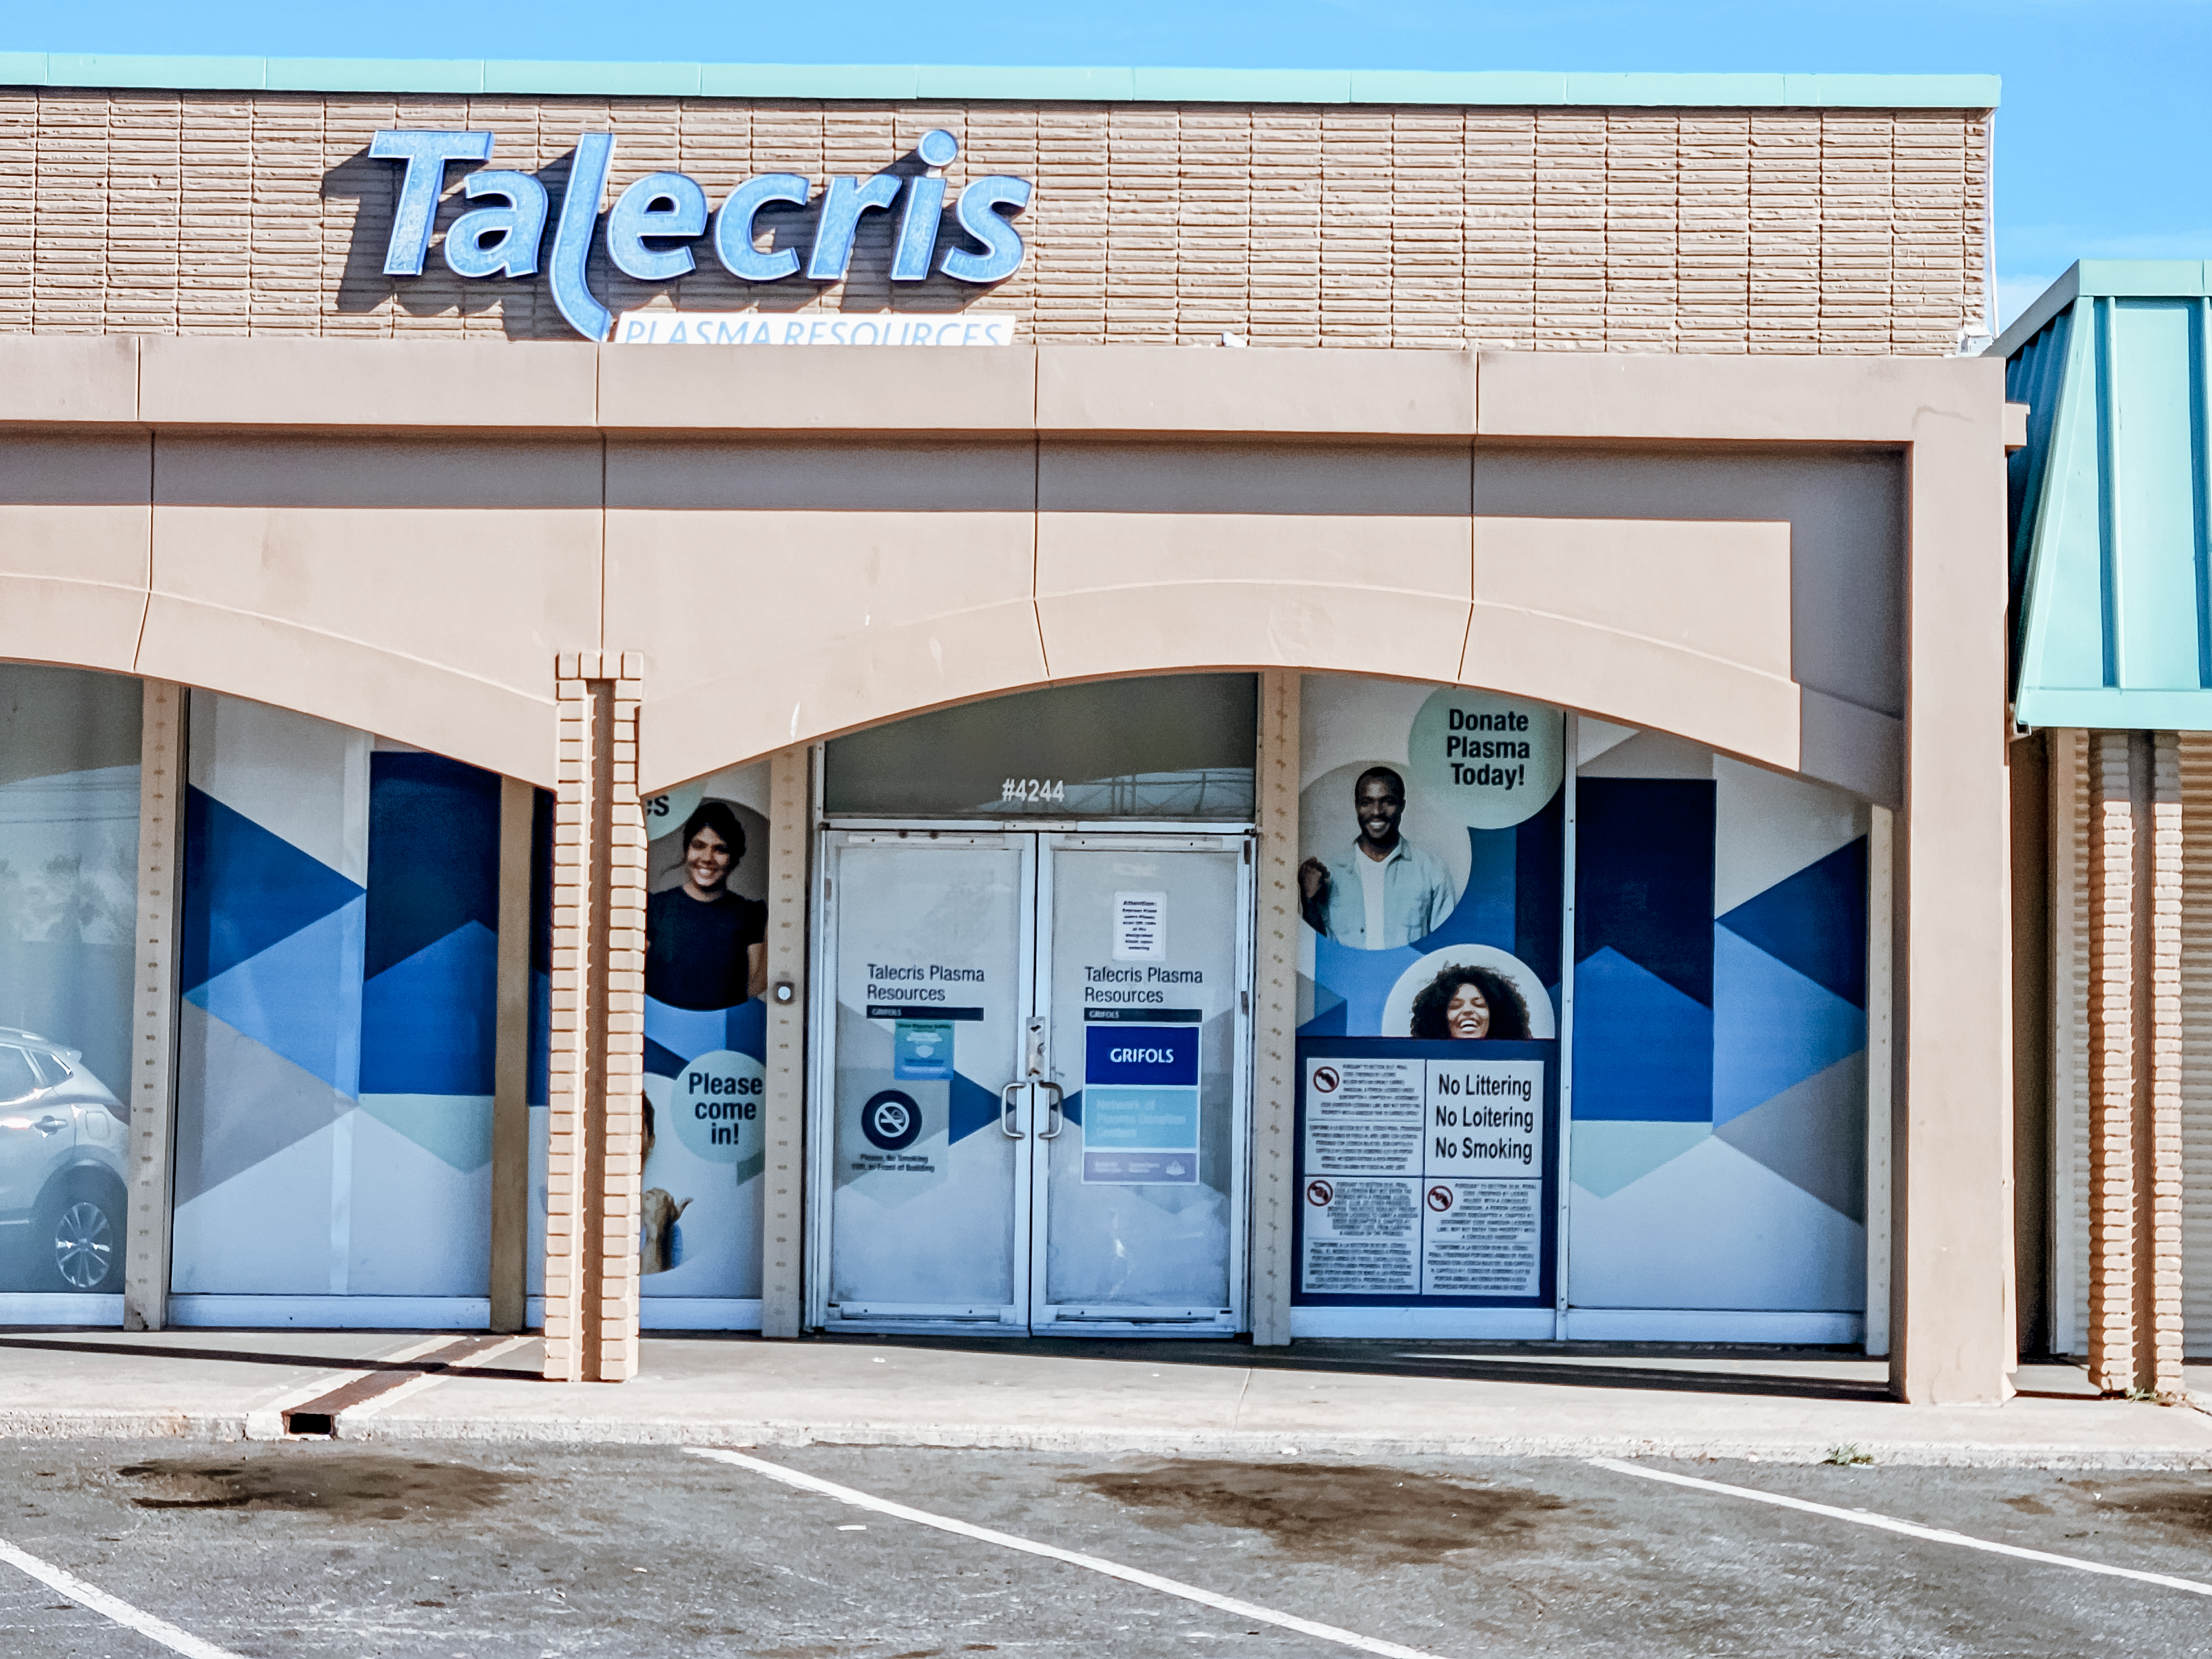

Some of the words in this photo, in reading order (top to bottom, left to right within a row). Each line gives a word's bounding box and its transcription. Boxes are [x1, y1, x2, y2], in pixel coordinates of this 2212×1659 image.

[368, 129, 1032, 342] Talecris
[1449, 708, 1528, 731] Donate
[1447, 735, 1530, 759] Plasma
[1451, 763, 1525, 790] Today!
[1002, 778, 1065, 802] #4244
[867, 963, 925, 980] Talecris
[929, 964, 985, 982] Plasma
[1084, 966, 1142, 983] Talecris
[1147, 967, 1203, 983] Plasma
[867, 984, 945, 1001] Resources
[1085, 987, 1164, 1003] Resources
[1110, 1048, 1173, 1063] GRIFOLS
[689, 1072, 763, 1095] Please
[1439, 1073, 1460, 1095] No
[1465, 1073, 1531, 1102] Littering
[695, 1102, 757, 1120] come
[1436, 1105, 1457, 1126] No
[1463, 1105, 1533, 1133] Loitering
[711, 1122, 739, 1145] in!
[1436, 1137, 1457, 1159] No
[1462, 1137, 1532, 1165] Smoking
